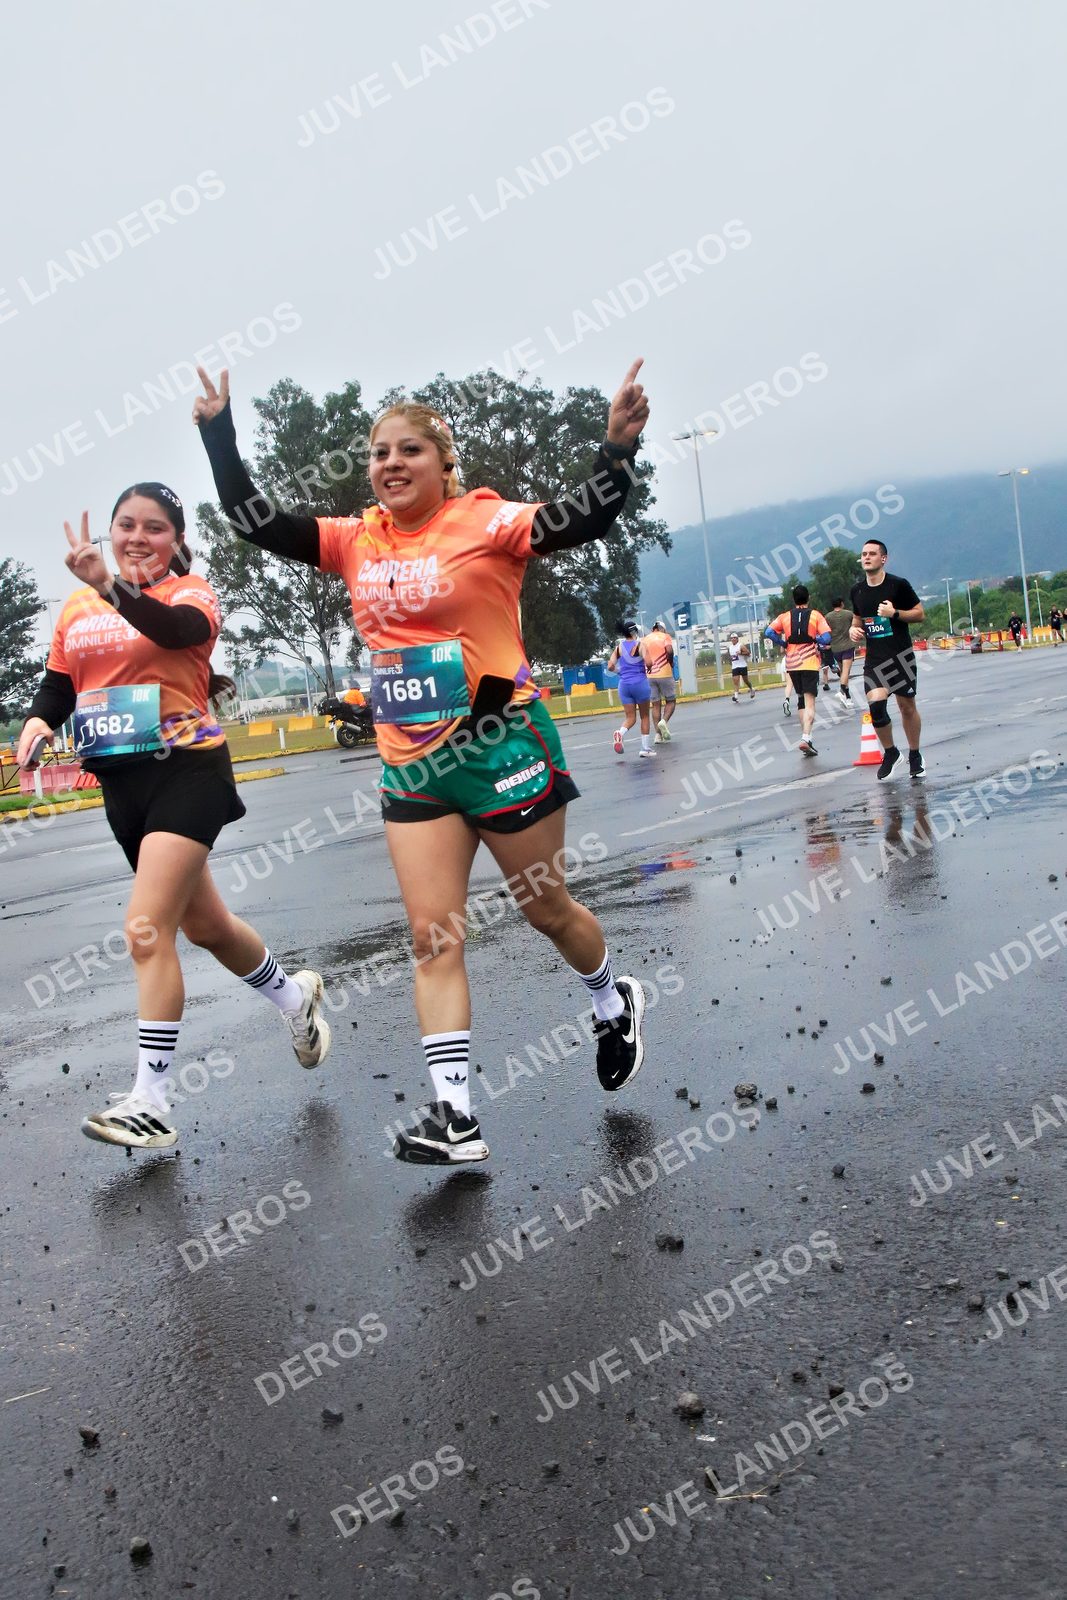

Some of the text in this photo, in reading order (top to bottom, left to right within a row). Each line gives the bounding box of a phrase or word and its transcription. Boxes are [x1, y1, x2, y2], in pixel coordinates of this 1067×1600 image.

[357, 554, 438, 583] CARRERA
[66, 613, 132, 639] CARRE
[677, 613, 688, 627] E
[868, 625, 884, 633] 1304
[431, 646, 452, 663] 10K
[132, 688, 151, 703] 10K
[382, 676, 437, 702] 1681
[85, 714, 135, 737] 1682
